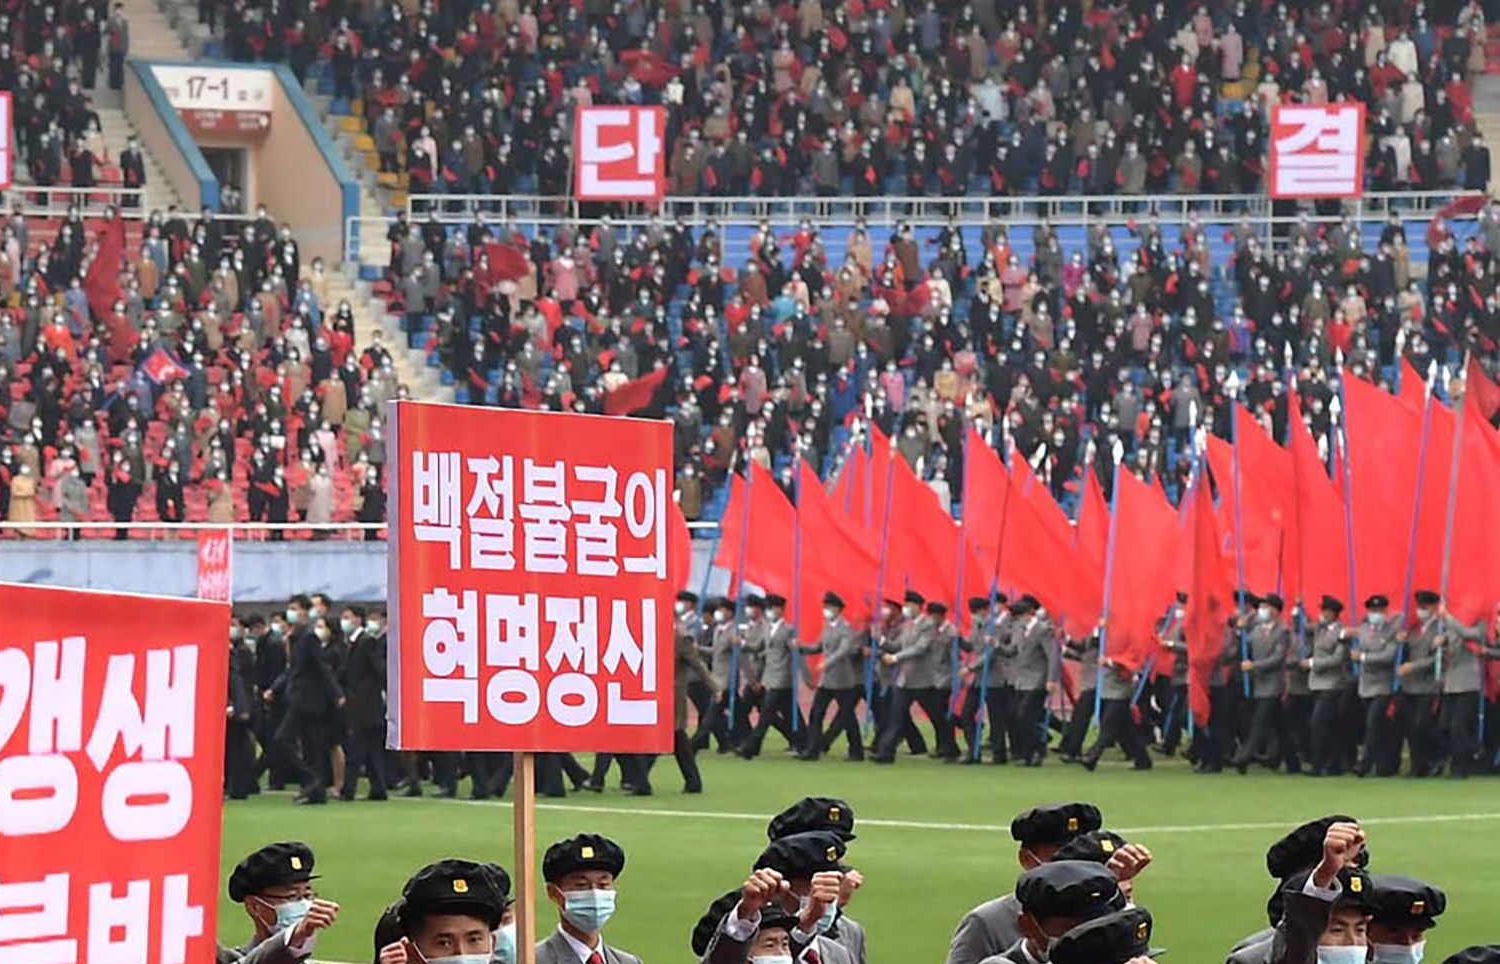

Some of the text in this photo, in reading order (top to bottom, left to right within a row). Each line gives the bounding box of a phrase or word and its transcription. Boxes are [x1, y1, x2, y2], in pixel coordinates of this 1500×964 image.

[186, 76, 228, 100] 17-1
[581, 109, 661, 196] 단
[1274, 107, 1359, 195] 결
[412, 450, 667, 580] 백절불굴의
[422, 586, 659, 728] 혁명정신
